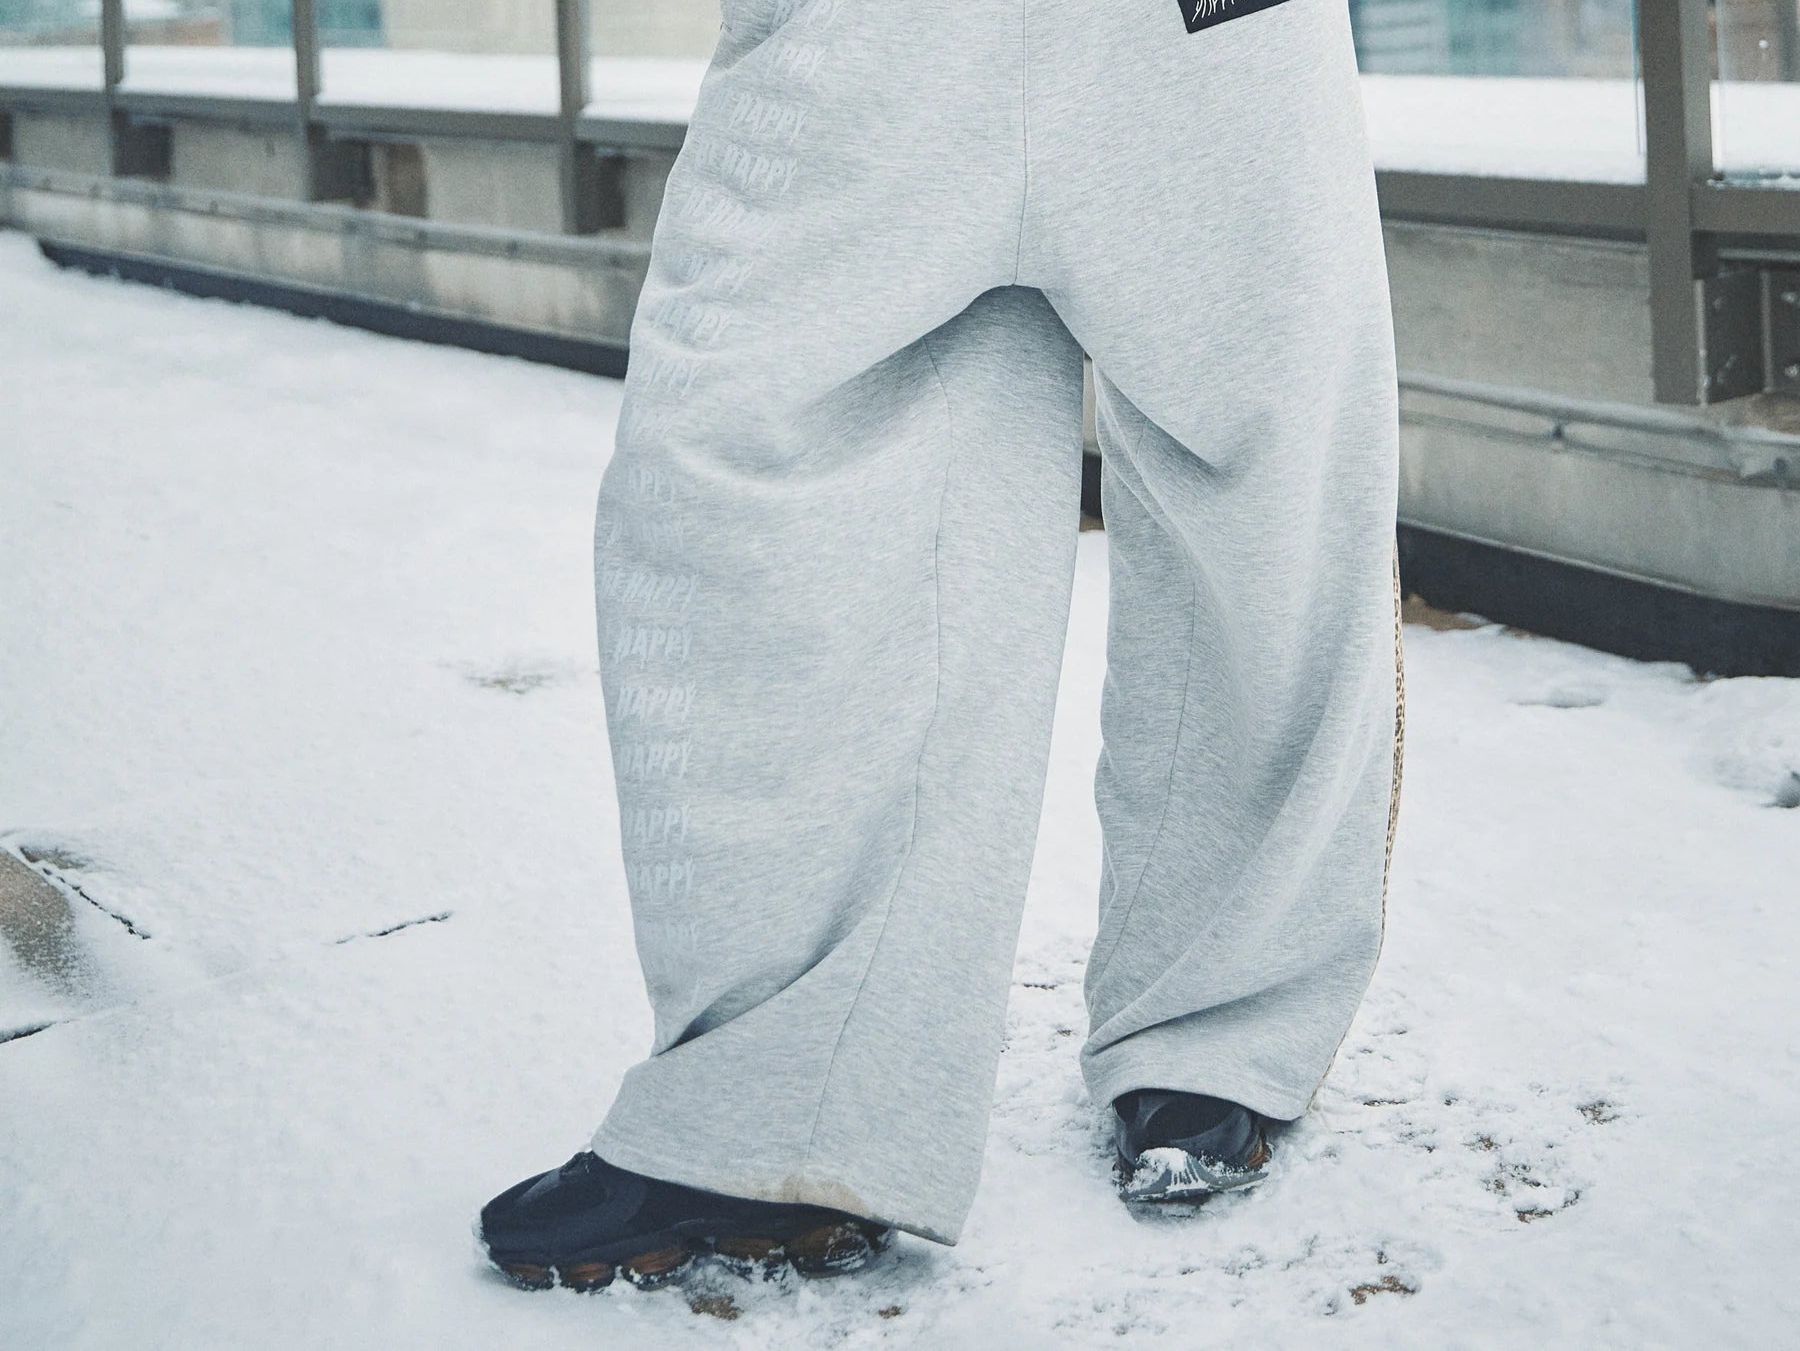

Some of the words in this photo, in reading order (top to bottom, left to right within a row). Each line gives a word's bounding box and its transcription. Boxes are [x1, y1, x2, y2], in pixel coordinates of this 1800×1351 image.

[728, 92, 808, 146] HAPPY
[720, 144, 798, 198] HAPPY
[621, 569, 699, 612] HAPPY
[614, 623, 694, 668] HAPPY
[615, 680, 698, 722] HAPPY
[617, 736, 693, 784] HAPPY
